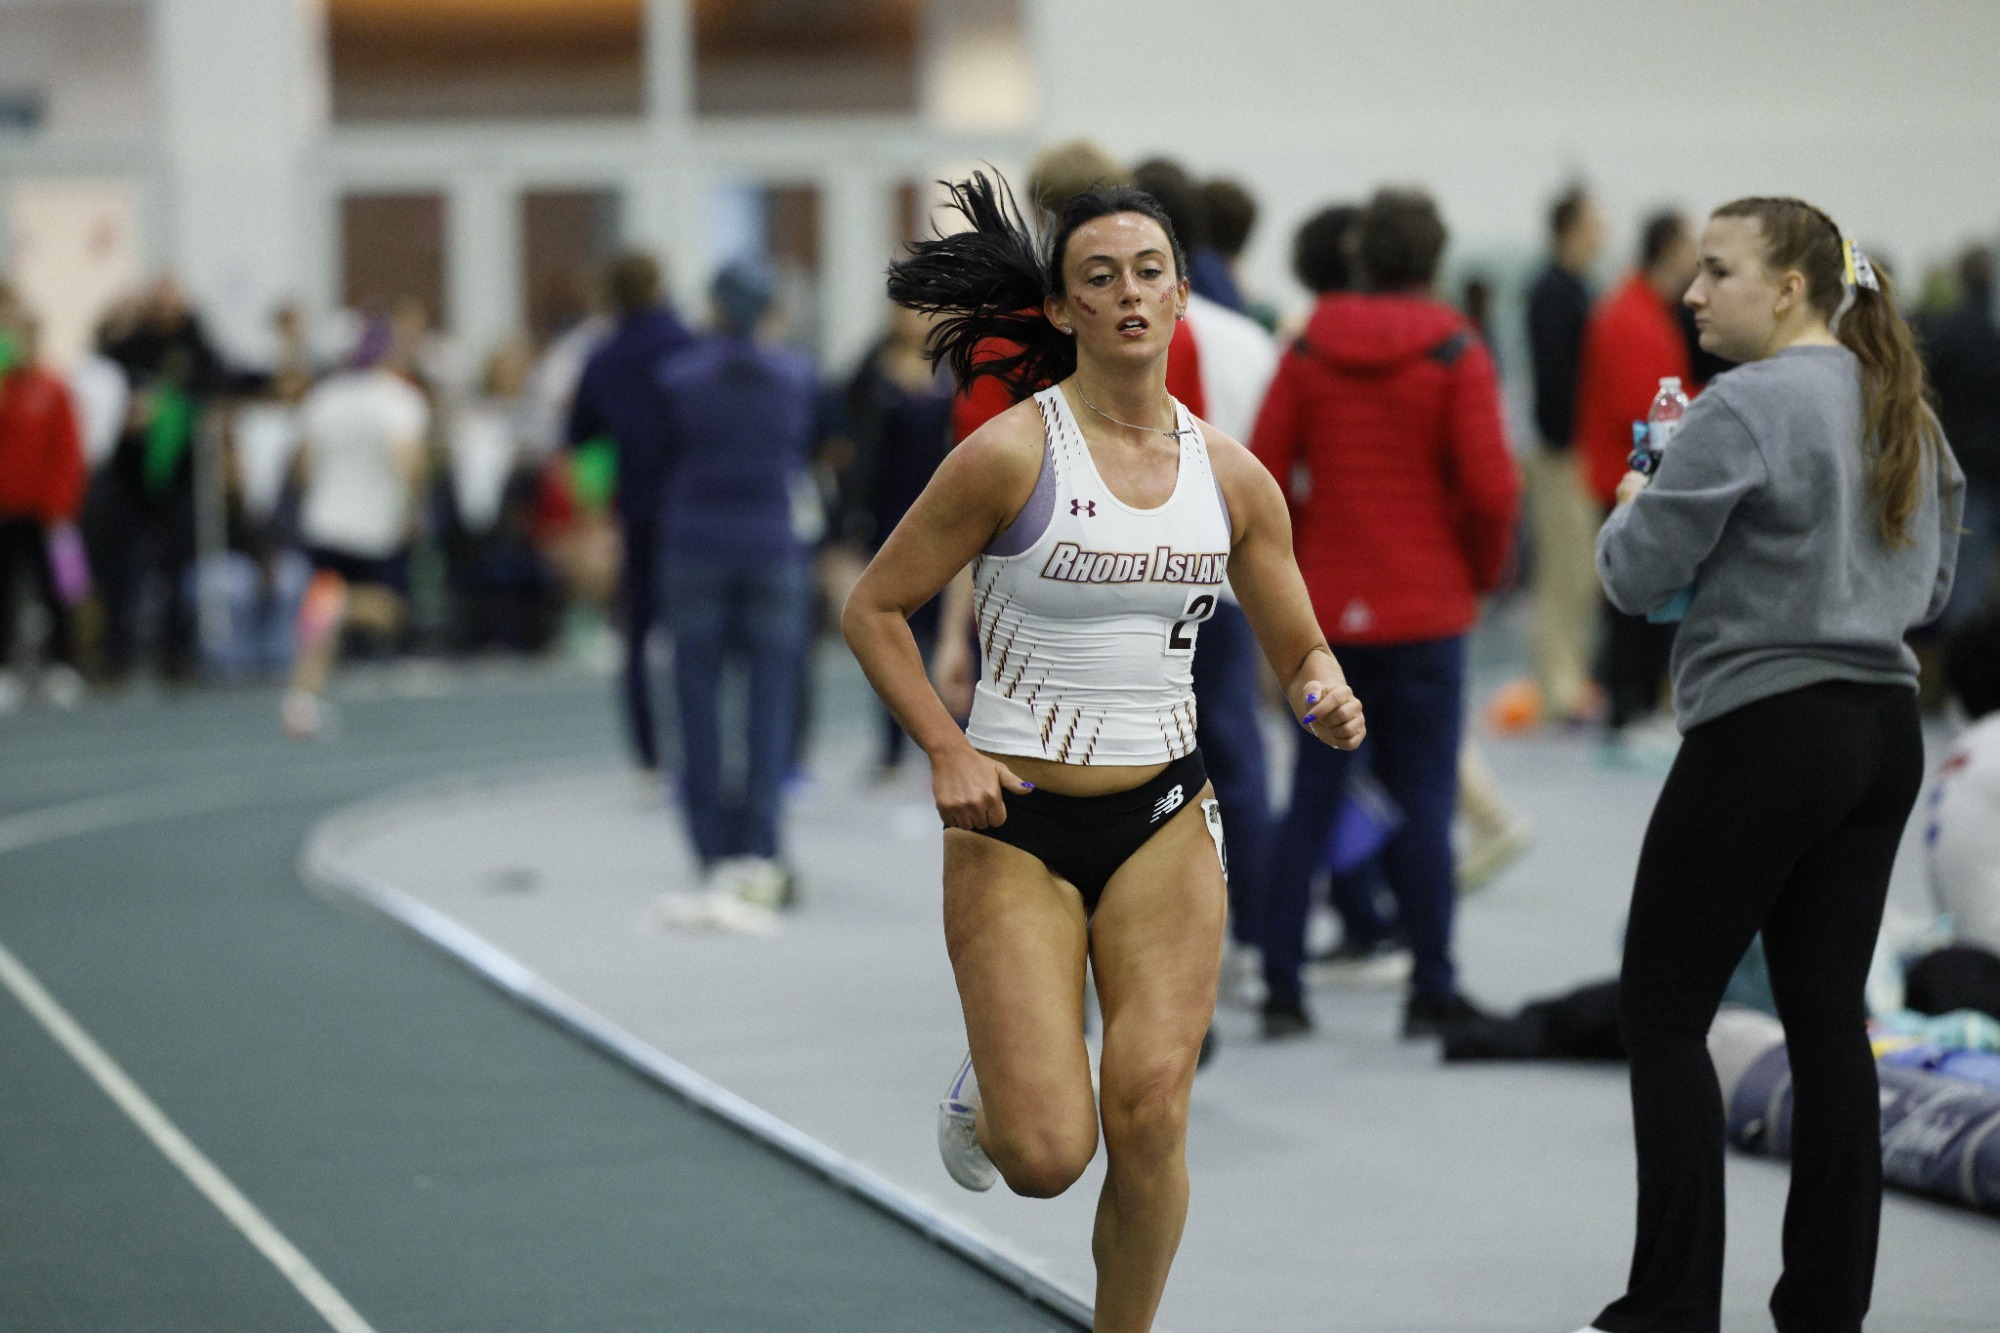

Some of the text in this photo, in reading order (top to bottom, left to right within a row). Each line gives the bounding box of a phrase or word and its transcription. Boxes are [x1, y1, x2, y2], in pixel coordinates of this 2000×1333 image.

[1040, 541, 1228, 585] RHODE ISLAN
[1168, 594, 1215, 650] 2
